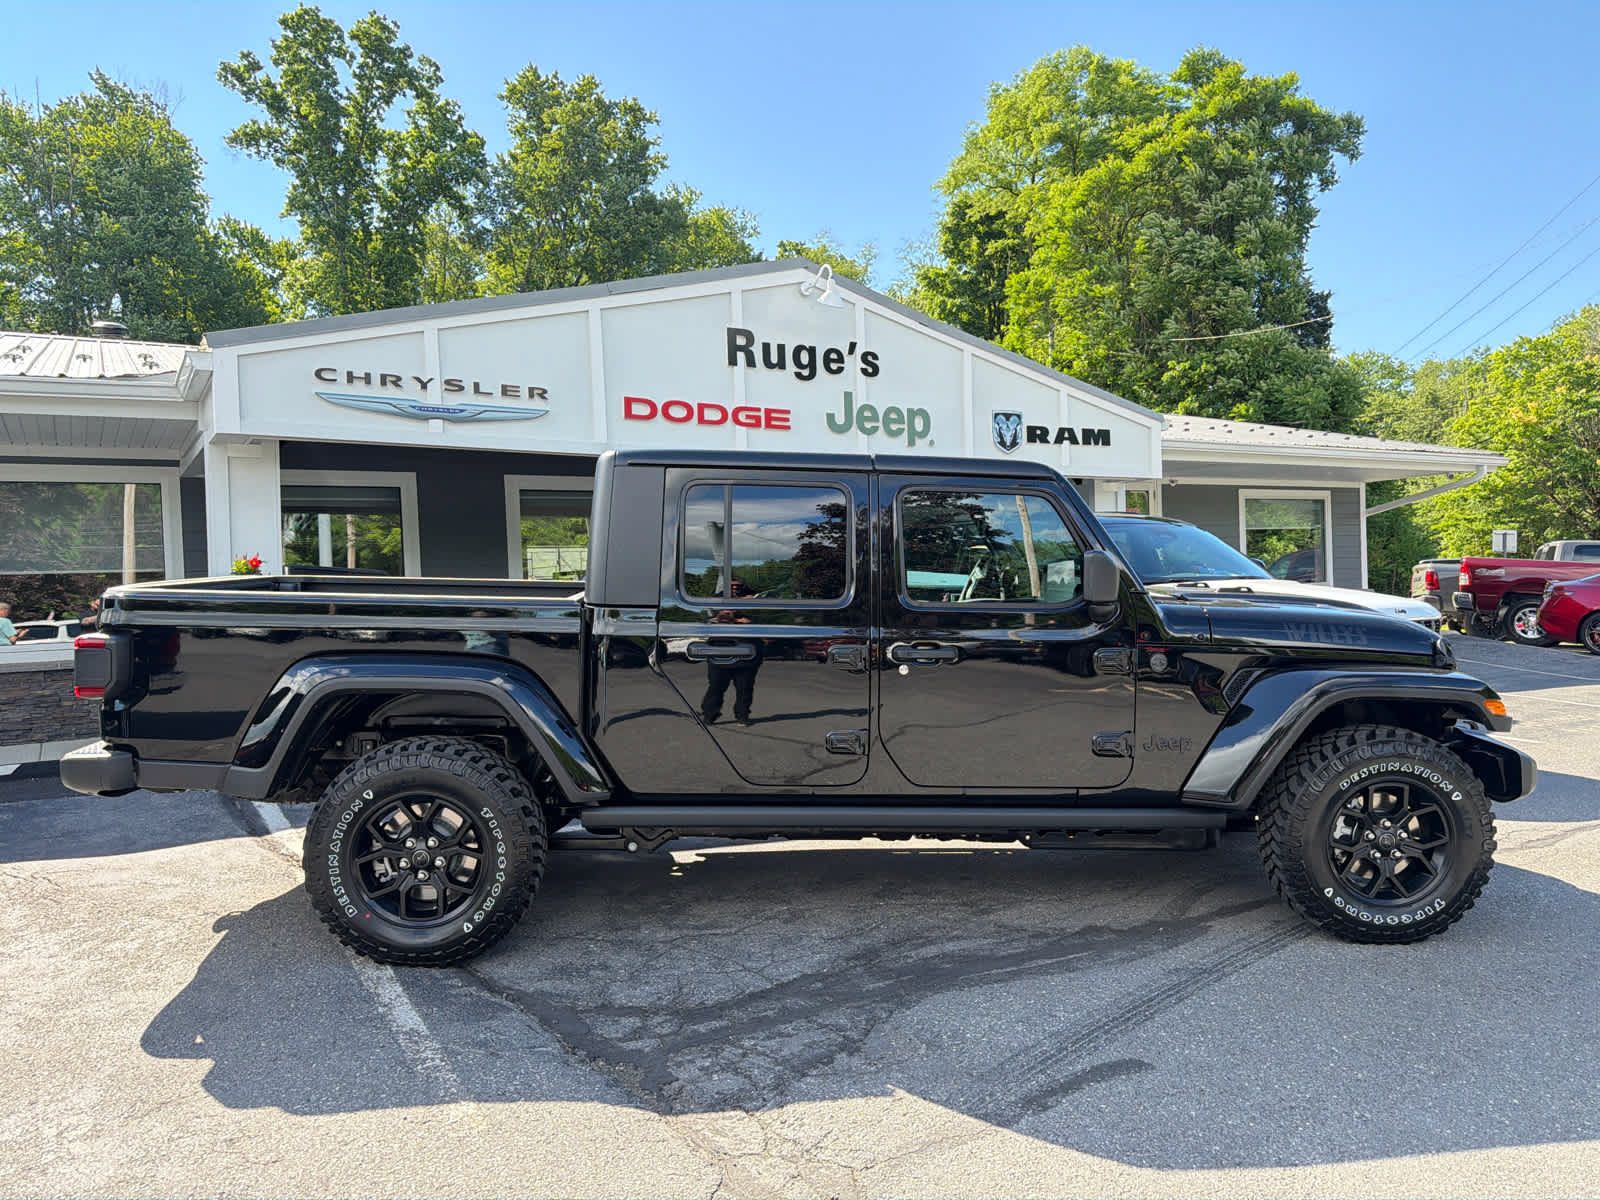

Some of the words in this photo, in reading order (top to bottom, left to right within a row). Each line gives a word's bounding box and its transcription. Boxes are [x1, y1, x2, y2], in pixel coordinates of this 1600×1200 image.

[726, 327, 880, 381] Ruge's
[314, 367, 549, 400] CHRYSLER
[623, 396, 791, 430] DODGE
[826, 391, 932, 447] Jeep
[1026, 425, 1111, 446] RAM
[1142, 735, 1193, 753] Jeep
[1339, 762, 1453, 791] DESTINATION
[328, 799, 363, 918] DESTINATION
